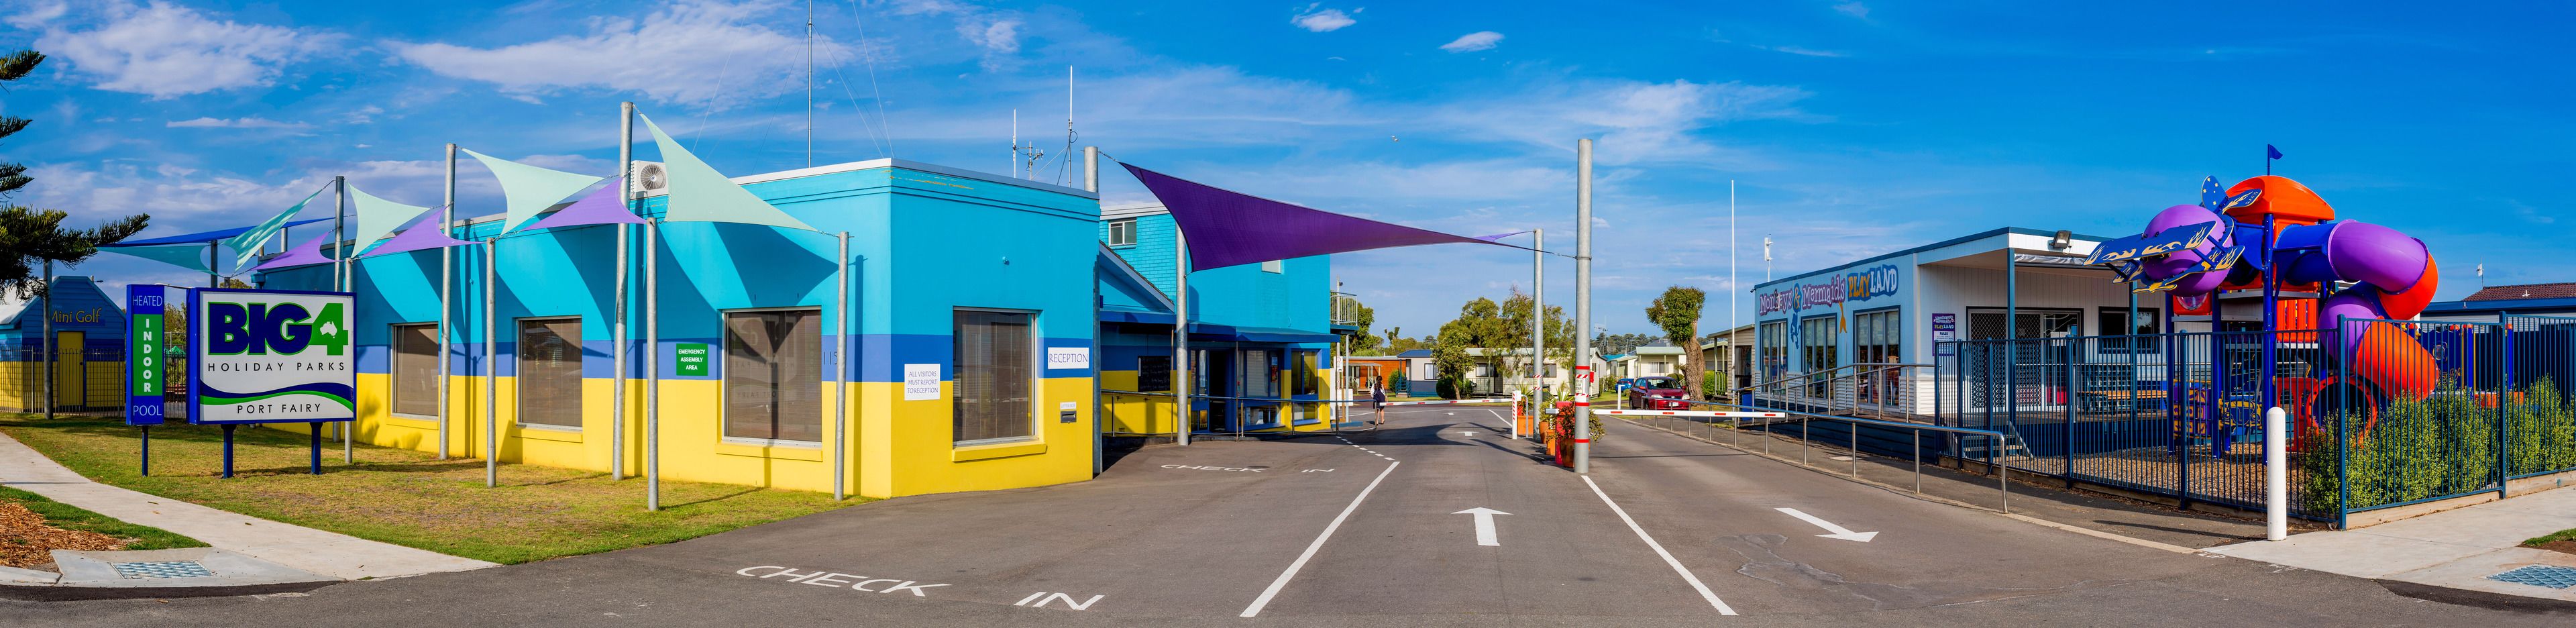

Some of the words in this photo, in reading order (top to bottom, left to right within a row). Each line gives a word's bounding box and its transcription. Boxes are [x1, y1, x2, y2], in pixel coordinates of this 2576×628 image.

[1760, 289, 1792, 313] Monkeys
[1794, 286, 1801, 309] &
[1803, 275, 1845, 307] Mermaids
[133, 295, 162, 307] HEATED
[76, 308, 101, 323] Golf
[208, 302, 348, 356] BIG4
[143, 319, 152, 392] INDOOR
[1049, 354, 1088, 363] RECEPTION
[208, 362, 284, 372] HOLIDAY
[297, 362, 344, 370] PARKS
[133, 405, 162, 416] POOL
[237, 405, 272, 414] PORT
[282, 404, 321, 413] FAIRY
[1161, 464, 1269, 472] CHECK
[737, 565, 953, 596] CHECK
[1014, 592, 1106, 611] IN
